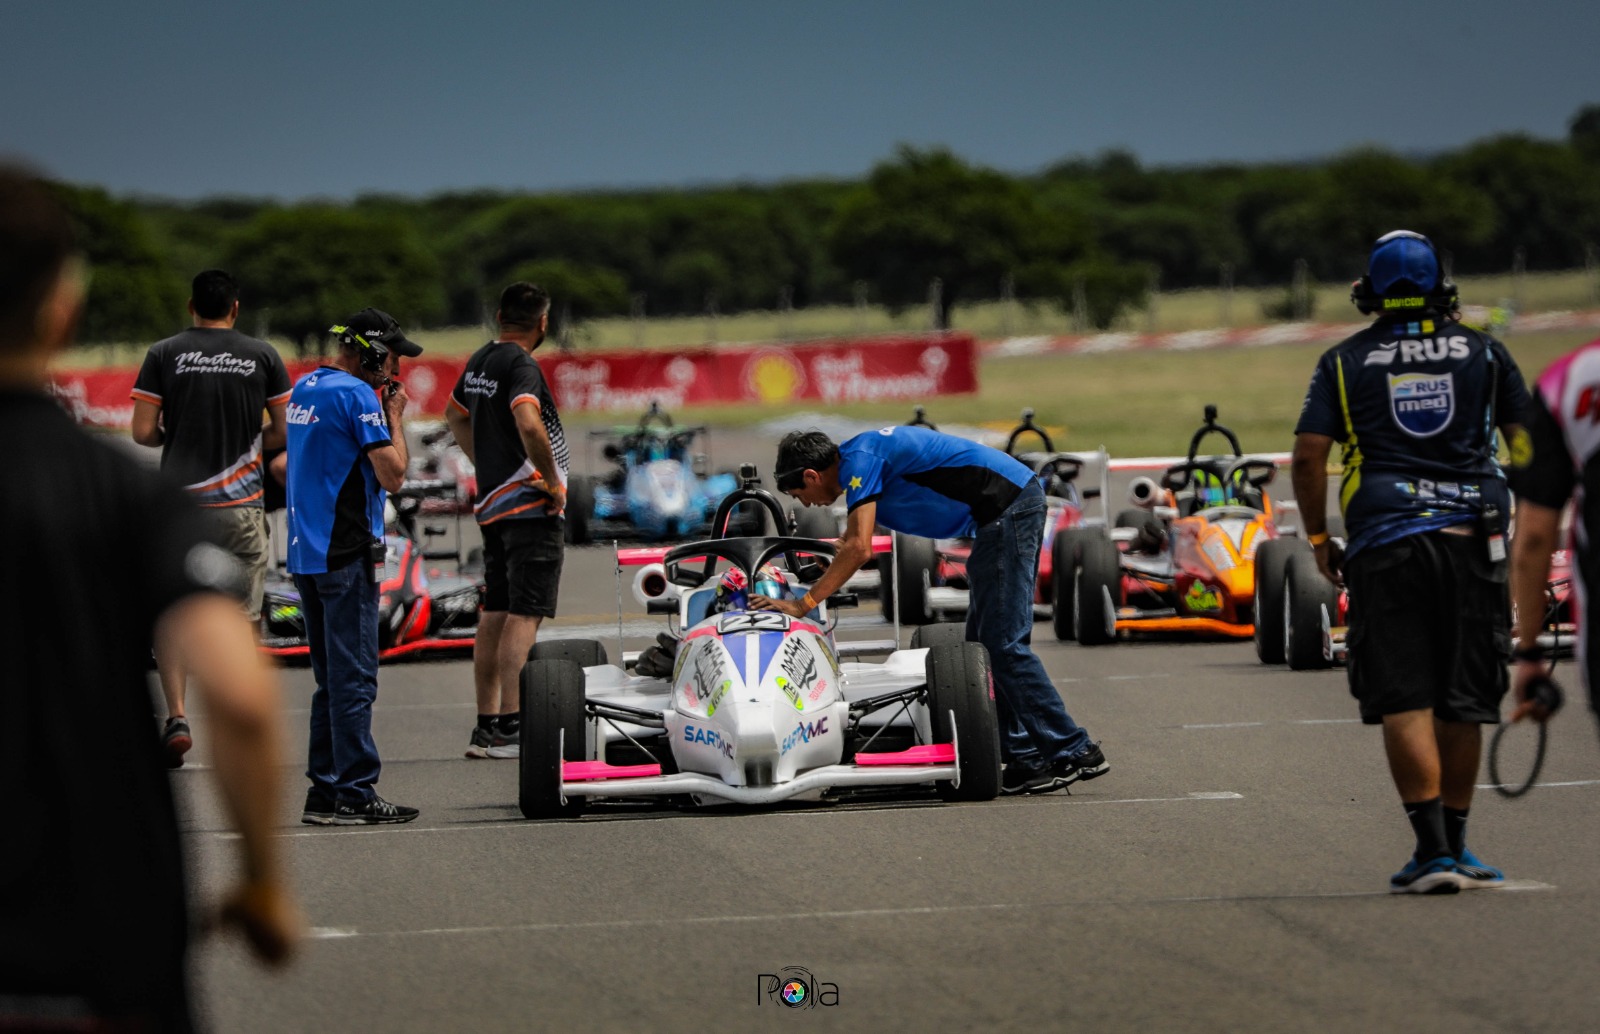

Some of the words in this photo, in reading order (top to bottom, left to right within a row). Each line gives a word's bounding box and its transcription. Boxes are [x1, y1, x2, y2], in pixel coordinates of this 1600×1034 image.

[1400, 335, 1470, 363] RUS
[1416, 380, 1449, 392] RUS
[1399, 394, 1448, 411] med
[722, 613, 783, 630] 22
